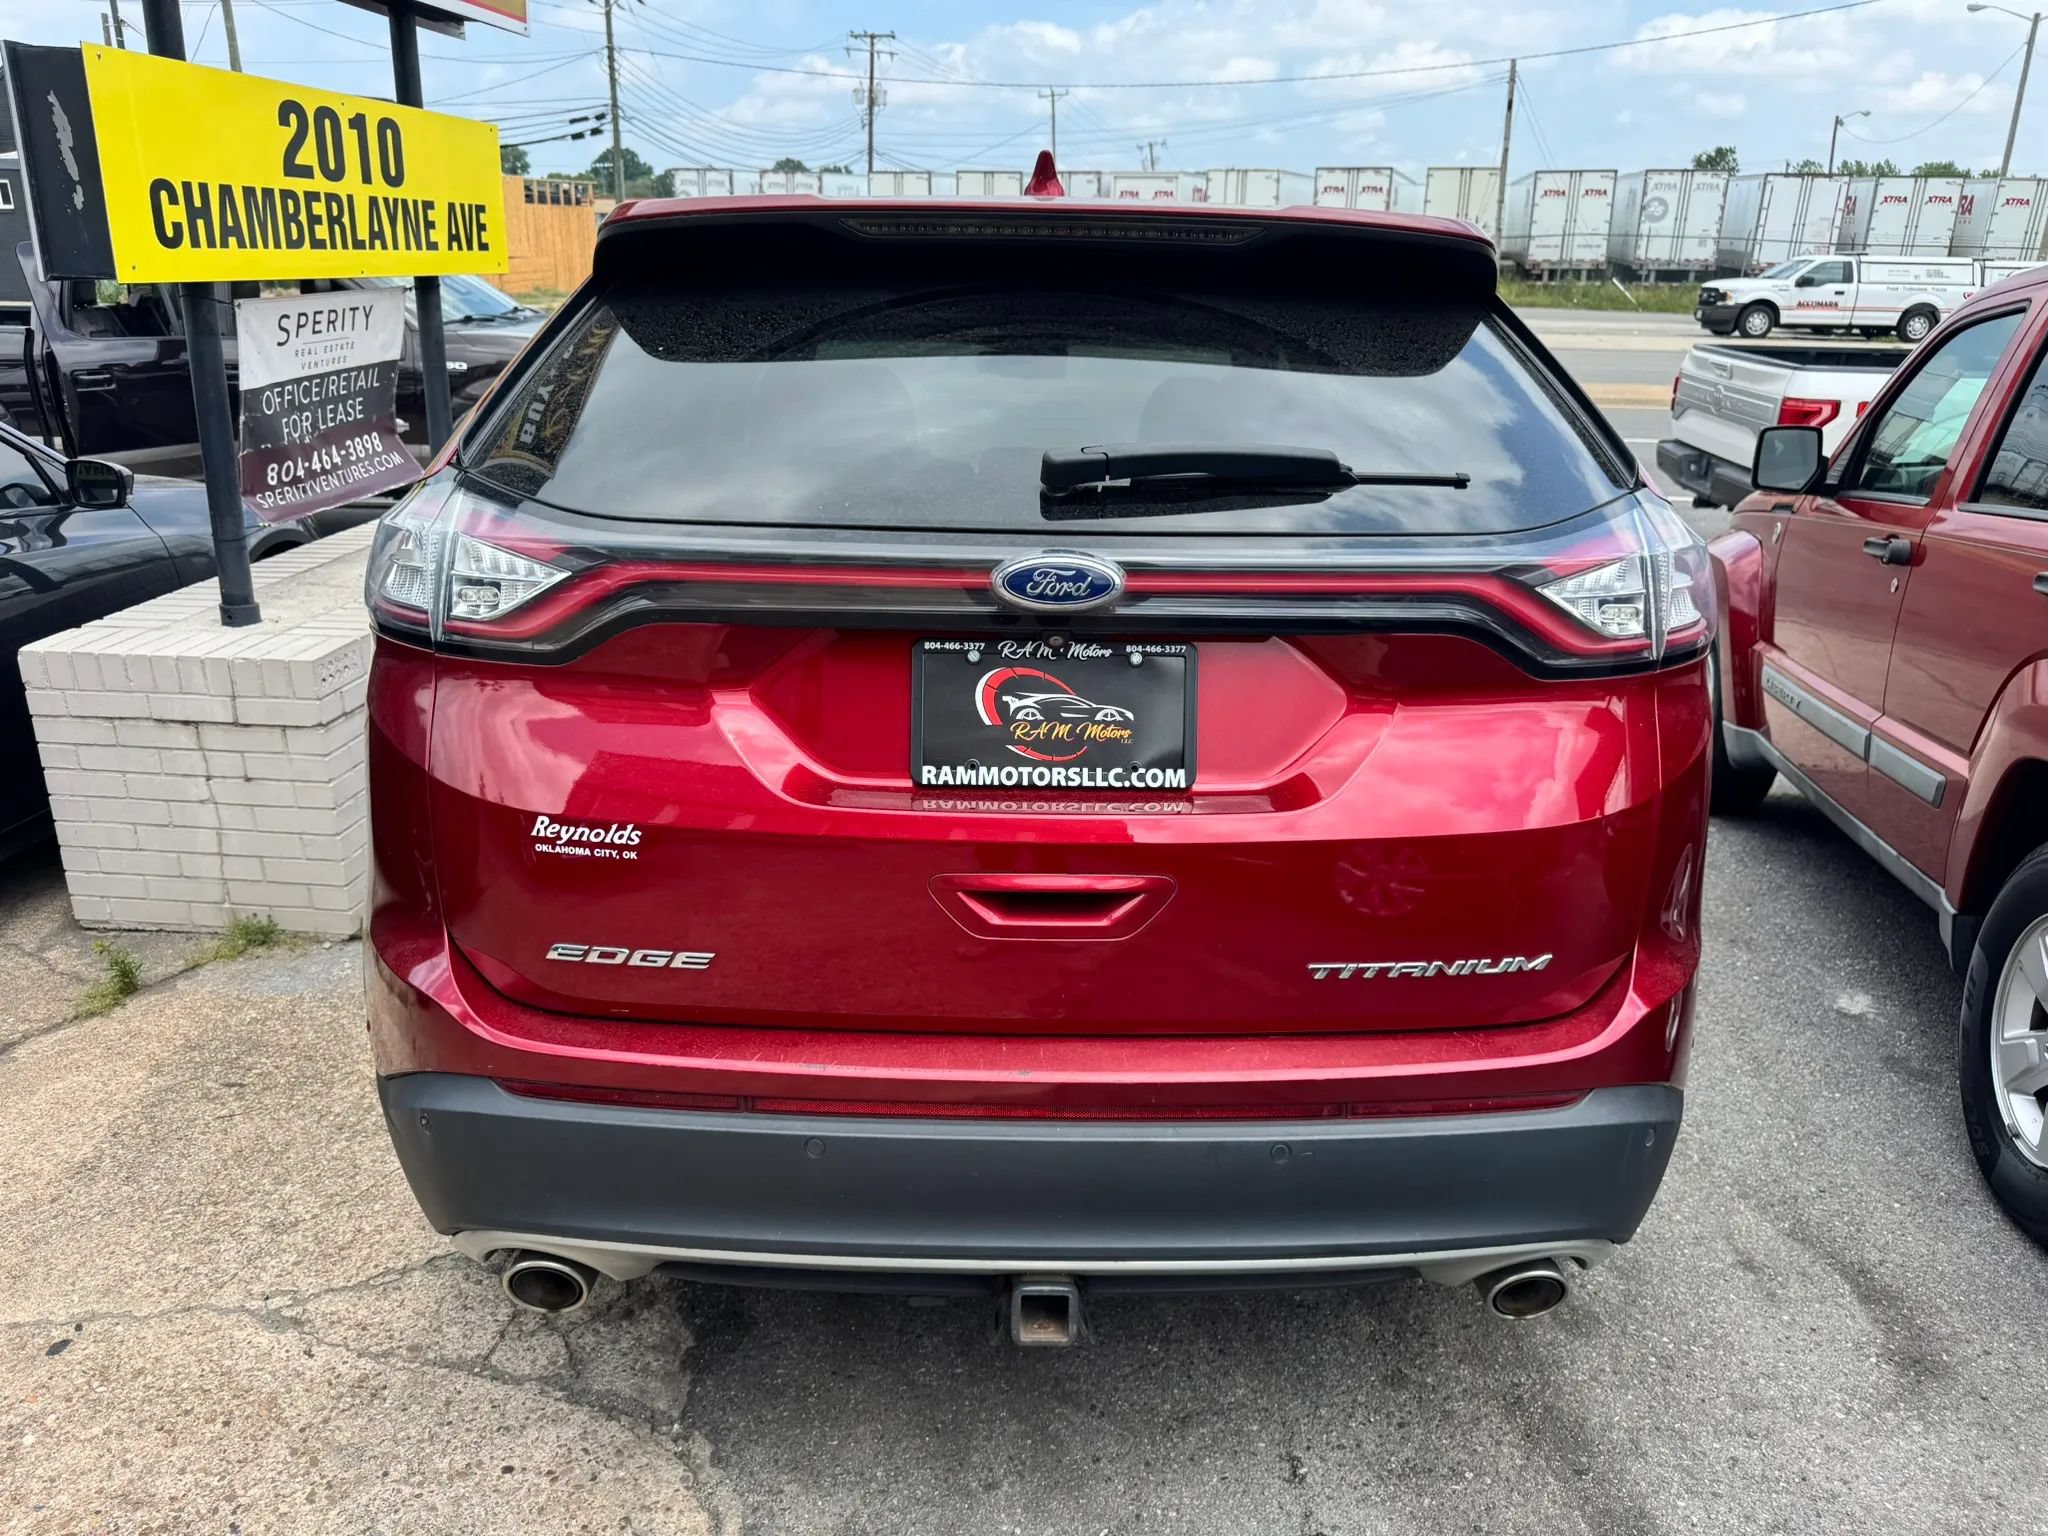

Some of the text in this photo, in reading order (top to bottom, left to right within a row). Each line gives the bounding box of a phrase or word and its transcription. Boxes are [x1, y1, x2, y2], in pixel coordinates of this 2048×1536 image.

[278, 99, 405, 188] 2010
[1880, 195, 1908, 205] XTRA
[1925, 195, 1953, 205] XTRA
[2001, 197, 2030, 207] XTRA
[149, 178, 489, 252] CHAMBERLAYNE AVE
[276, 304, 373, 347] SPERITY
[262, 367, 380, 415] OFFICE/RETAIL
[281, 397, 365, 442] FOR LEASE
[267, 431, 383, 486] 804-464-3898
[255, 451, 405, 509] SPERITYVENTURES.COM
[1026, 568, 1092, 597] Ford
[924, 641, 986, 650] 804-466-3377
[998, 640, 1113, 660] RAM Motors
[1126, 644, 1187, 653] 804-466-3377
[1011, 721, 1133, 742] RAM Motors
[921, 765, 1187, 788] RAMMOTORSLLC.COM
[531, 815, 642, 846] Reynolds
[535, 843, 638, 860] OKLAHOMA CITY, OK
[545, 943, 716, 970] EDGE
[1307, 953, 1553, 980] TITANIUM
